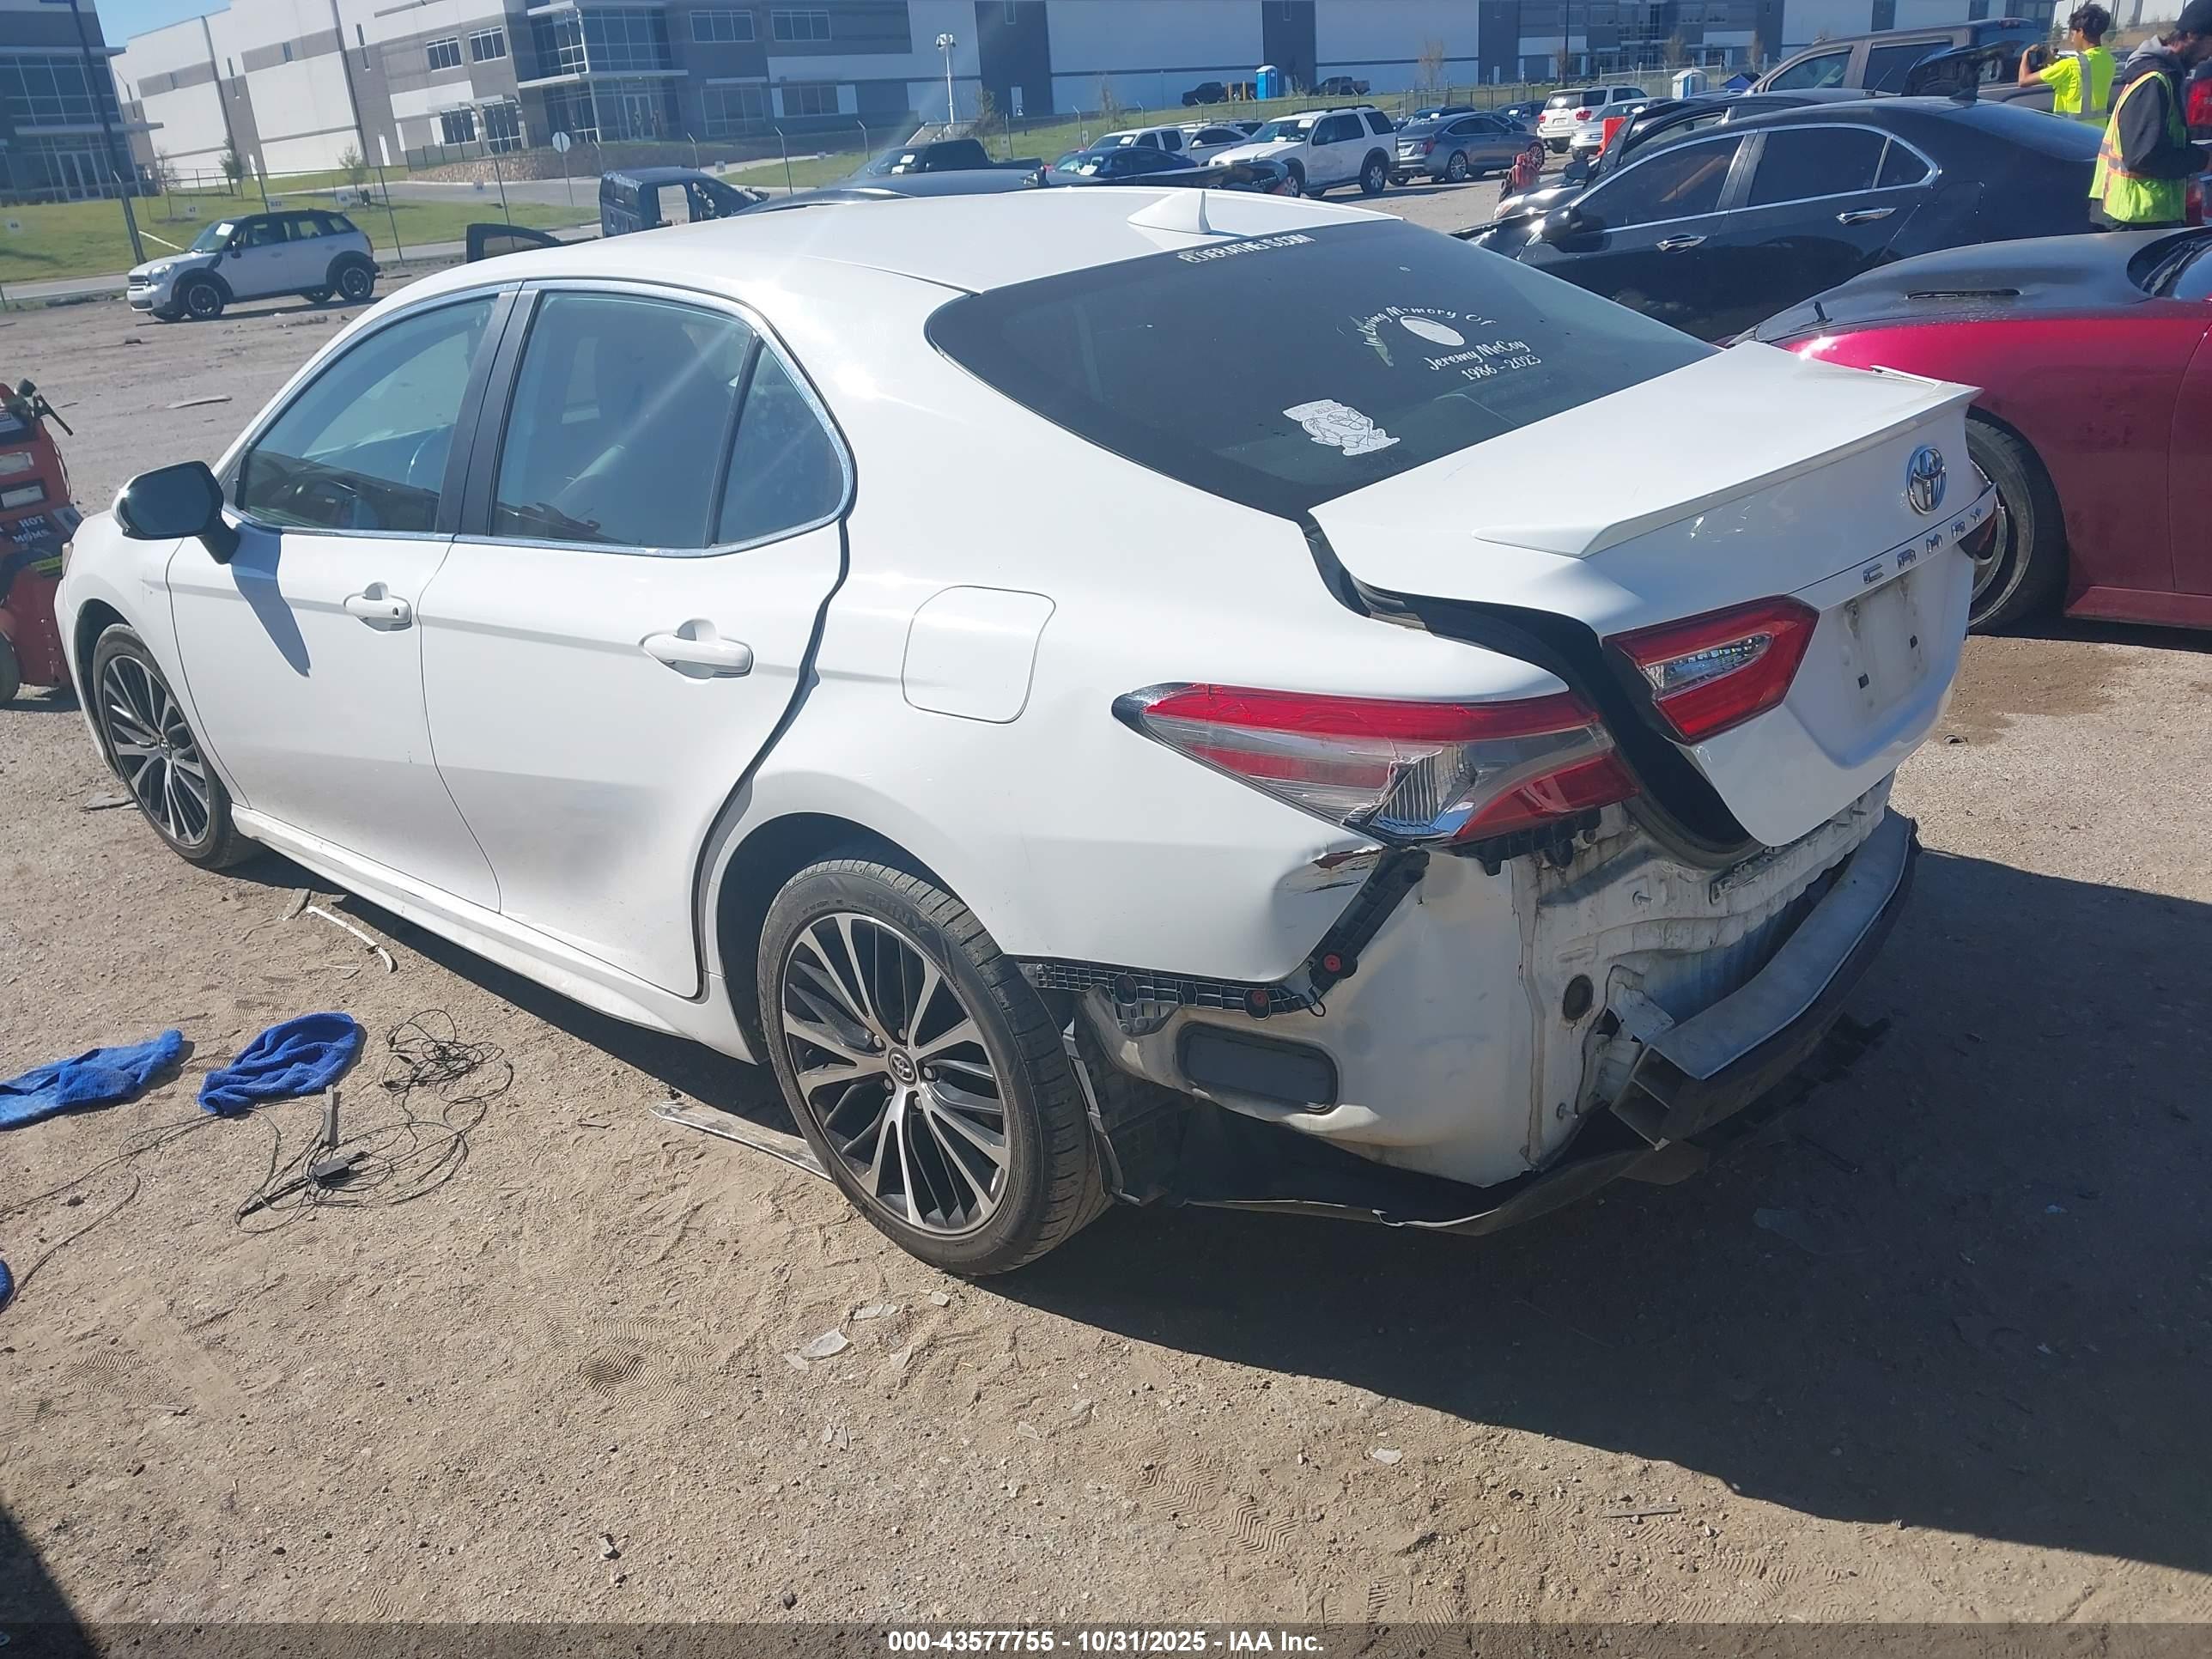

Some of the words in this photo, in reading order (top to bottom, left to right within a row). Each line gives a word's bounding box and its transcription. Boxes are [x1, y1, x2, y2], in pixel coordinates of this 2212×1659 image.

[1385, 306, 1457, 319] Memory
[1465, 314, 1498, 326] Of
[1423, 349, 1484, 371] Jeremy
[1475, 340, 1531, 356] McCoy
[1461, 363, 1498, 380] 1986
[1504, 354, 1542, 370] 2023
[19, 515, 46, 528] HOT
[1863, 507, 1983, 585] CAMRY
